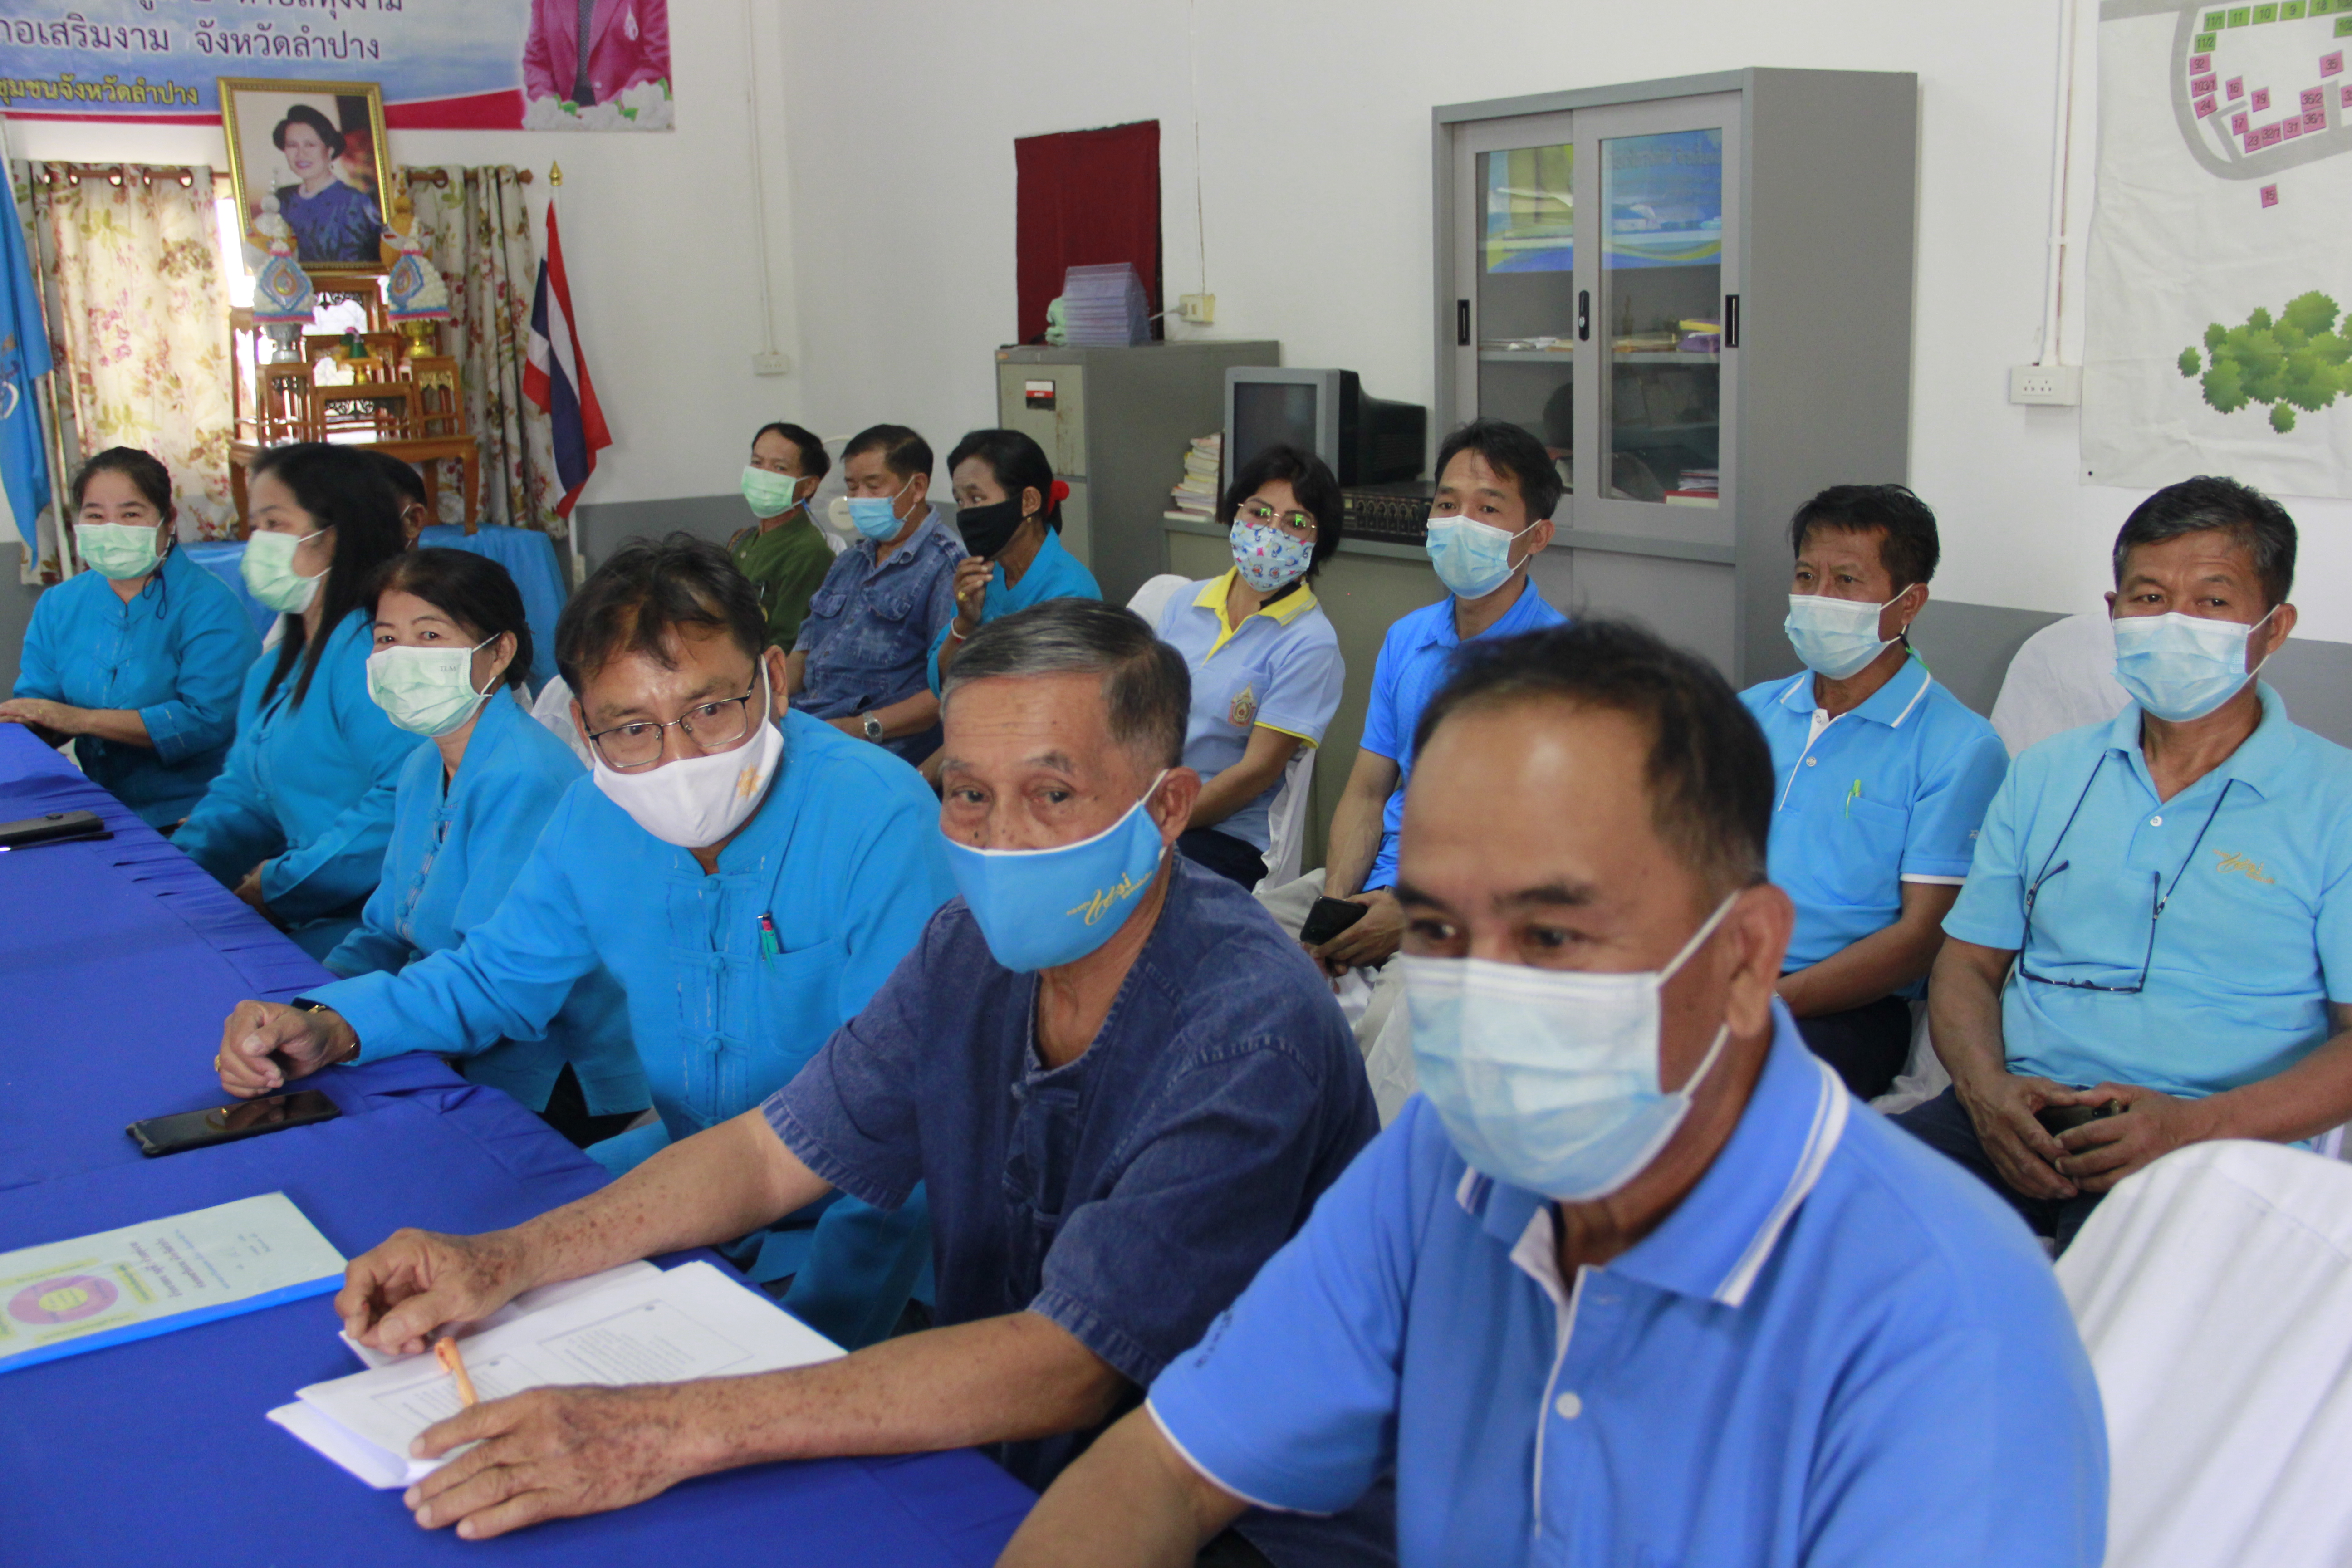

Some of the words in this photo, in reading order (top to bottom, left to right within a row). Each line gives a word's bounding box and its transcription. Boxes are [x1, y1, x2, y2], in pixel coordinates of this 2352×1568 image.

[2259, 8, 2271, 19] 10
[2289, 5, 2297, 15] 9
[2233, 12, 2243, 23] 11
[195, 19, 379, 59] จังหวัดลำปาง
[2197, 37, 2214, 49] 11/2
[2194, 59, 2205, 69] 92
[2256, 93, 2267, 104] 19
[2200, 100, 2211, 110] 24
[2234, 118, 2244, 128] 17
[2287, 122, 2298, 133] 31
[2248, 136, 2259, 146] 23
